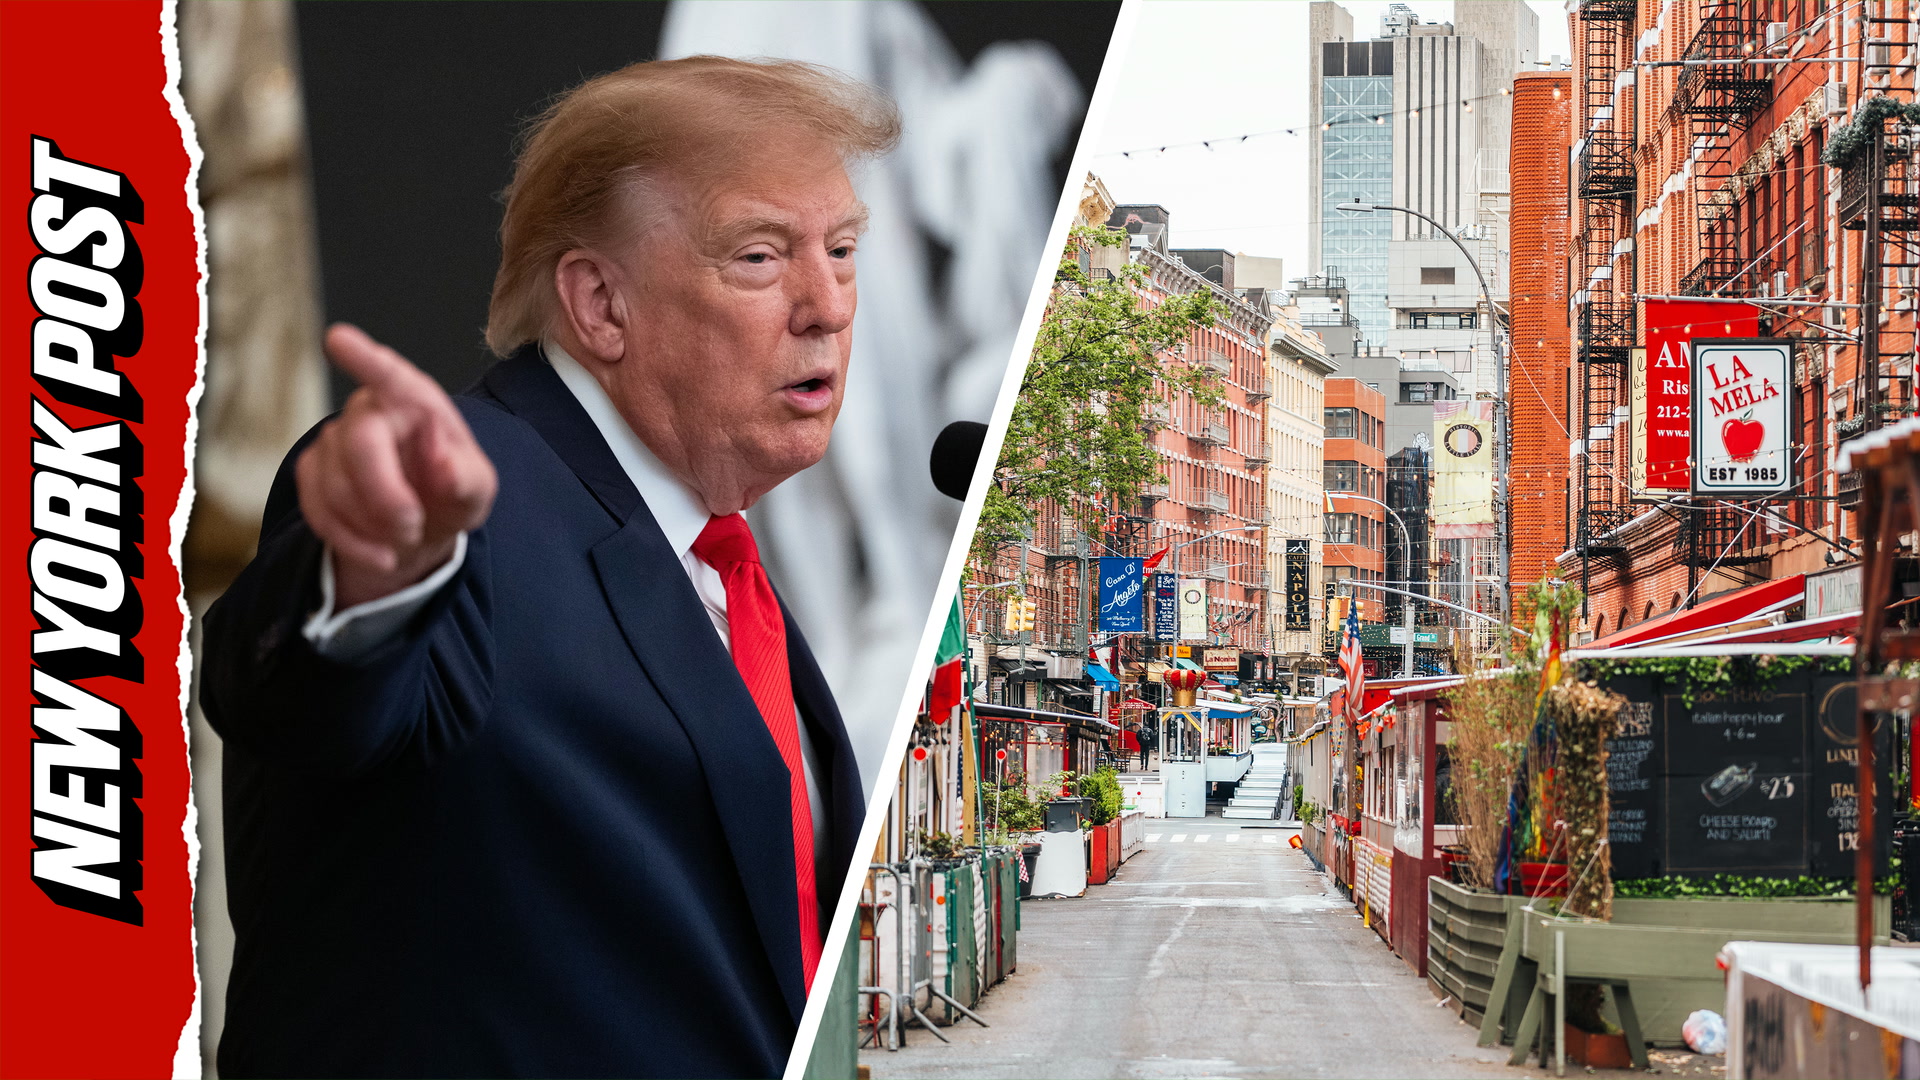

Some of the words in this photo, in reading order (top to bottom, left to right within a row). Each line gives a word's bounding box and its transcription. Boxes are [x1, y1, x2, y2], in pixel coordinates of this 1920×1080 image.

[1706, 355, 1753, 390] LA
[1708, 377, 1779, 418] MELA
[1449, 424, 1478, 433] HISTORIC
[1656, 429, 1690, 438] www.a
[1444, 441, 1464, 457] LITTLE
[1466, 441, 1482, 457] ITALY
[1709, 468, 1737, 480] EST
[1744, 467, 1778, 481] 1985
[1105, 573, 1126, 588] Casa
[1101, 579, 1140, 613] Angelo
[1290, 561, 1305, 623] NAPOLI
[1205, 654, 1214, 663] La
[1692, 711, 1722, 724] italian
[1722, 710, 1757, 726] happy
[1757, 711, 1784, 724] hour
[1699, 814, 1740, 828] CHEESE
[1741, 815, 1778, 829] BOARD
[1706, 828, 1731, 840] AND
